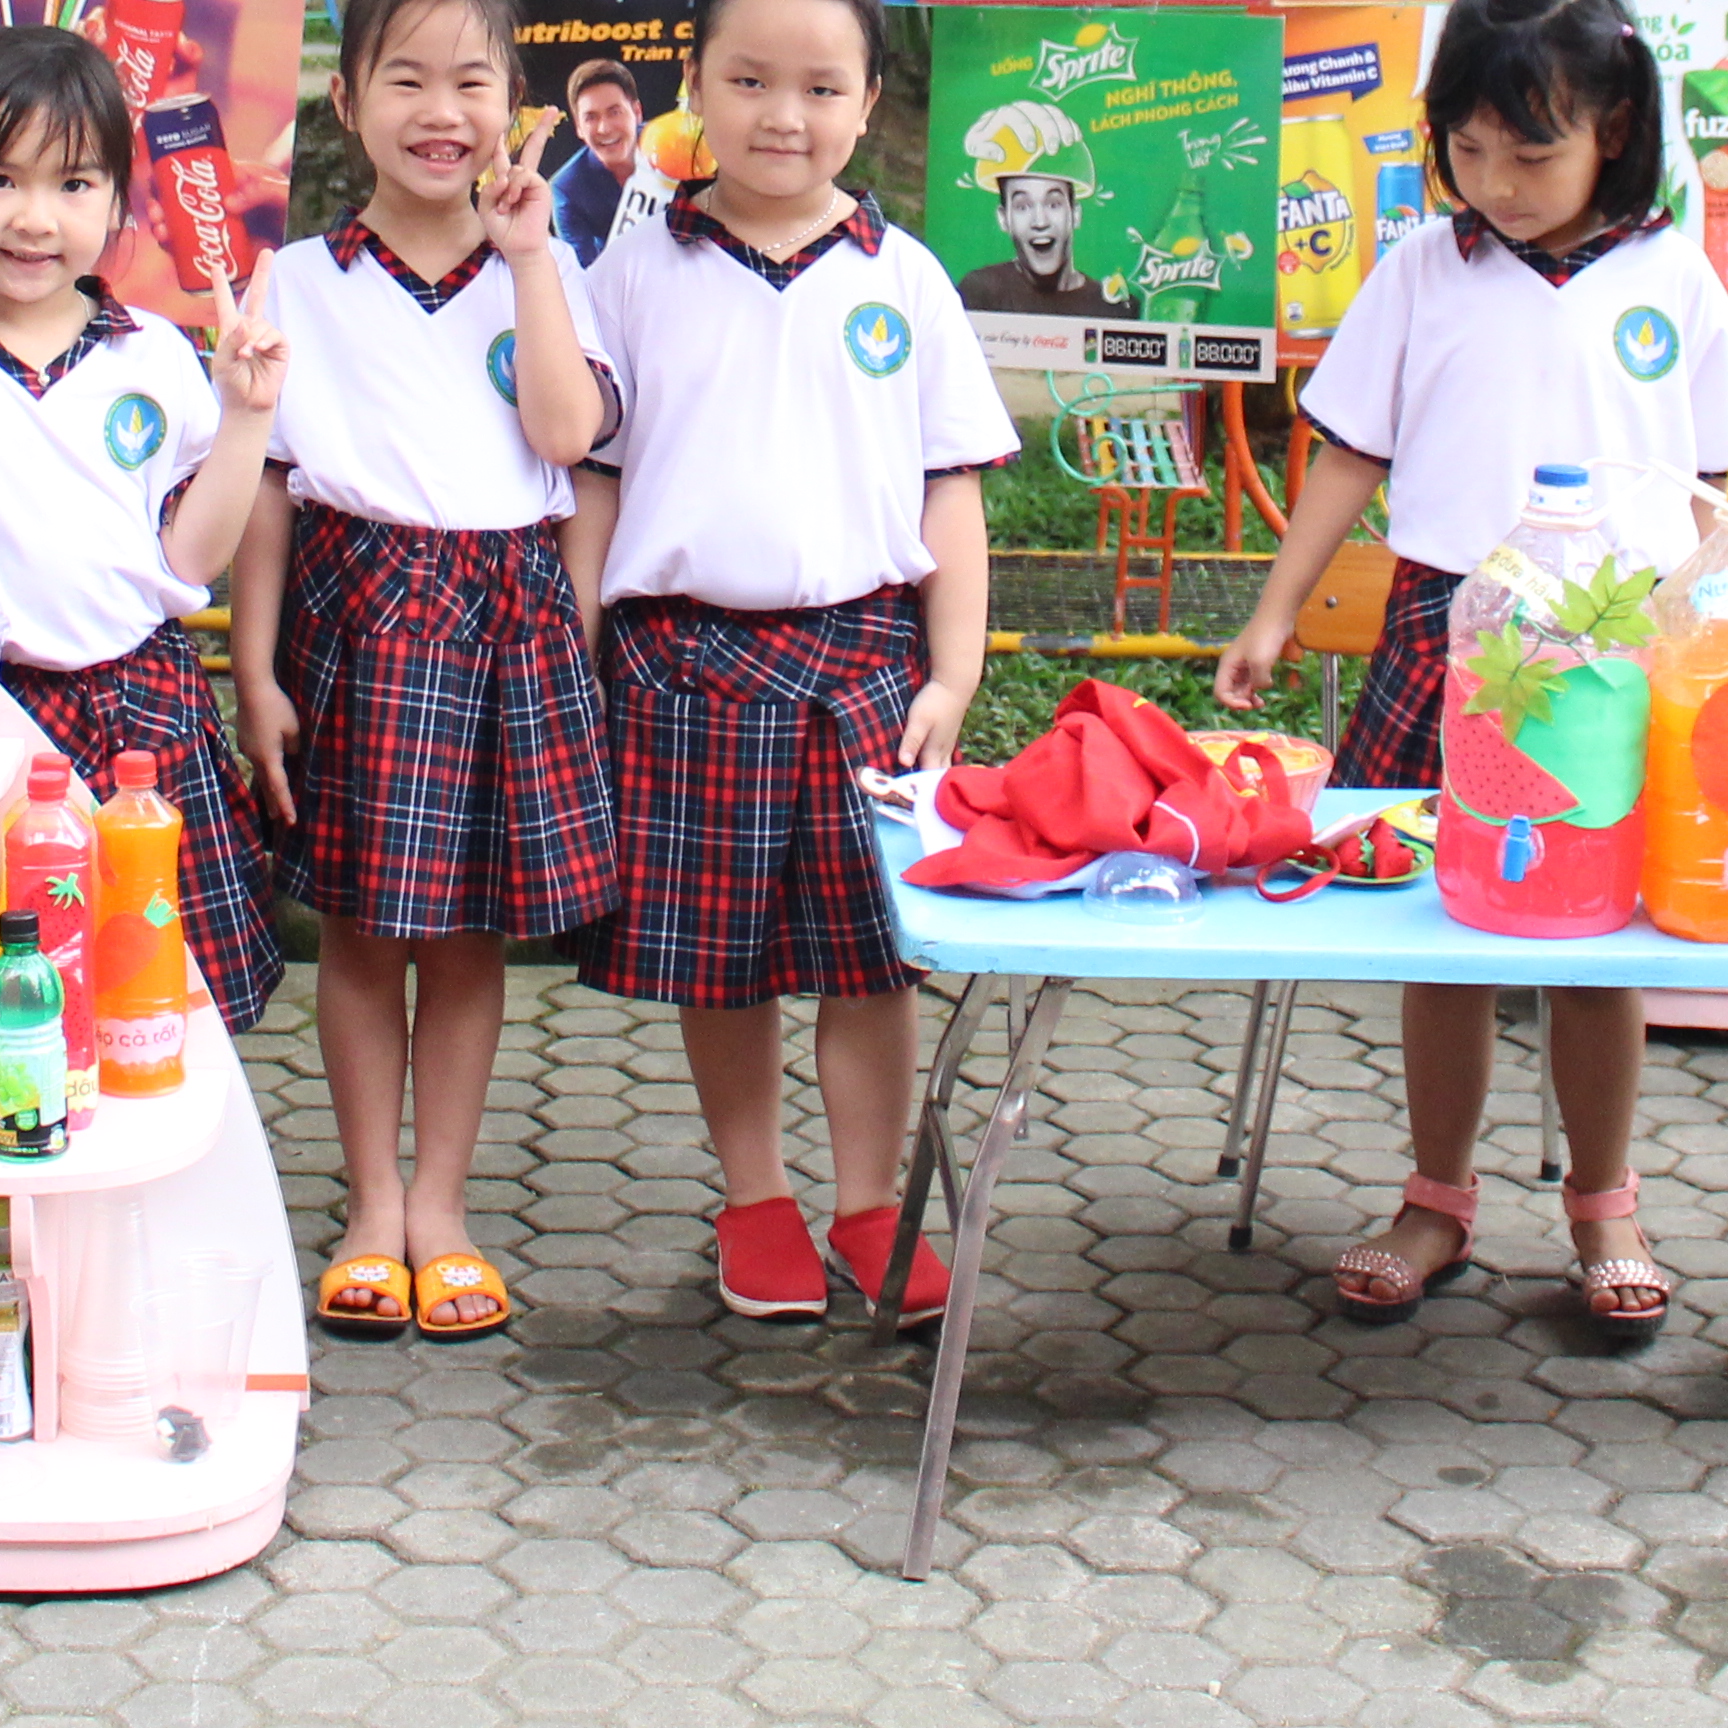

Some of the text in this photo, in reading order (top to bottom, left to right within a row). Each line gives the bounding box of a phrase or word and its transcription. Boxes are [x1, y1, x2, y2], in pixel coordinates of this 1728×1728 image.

[513, 19, 665, 46] utriboost
[1041, 38, 1127, 90] Sprite
[1318, 51, 1364, 71] Chanh
[1311, 69, 1367, 89] Vitamin
[1367, 66, 1378, 80] C
[1134, 101, 1193, 124] PHONG
[1278, 190, 1351, 231] FANTA
[1139, 249, 1217, 289] Sprite
[118, 1028, 147, 1048] cà
